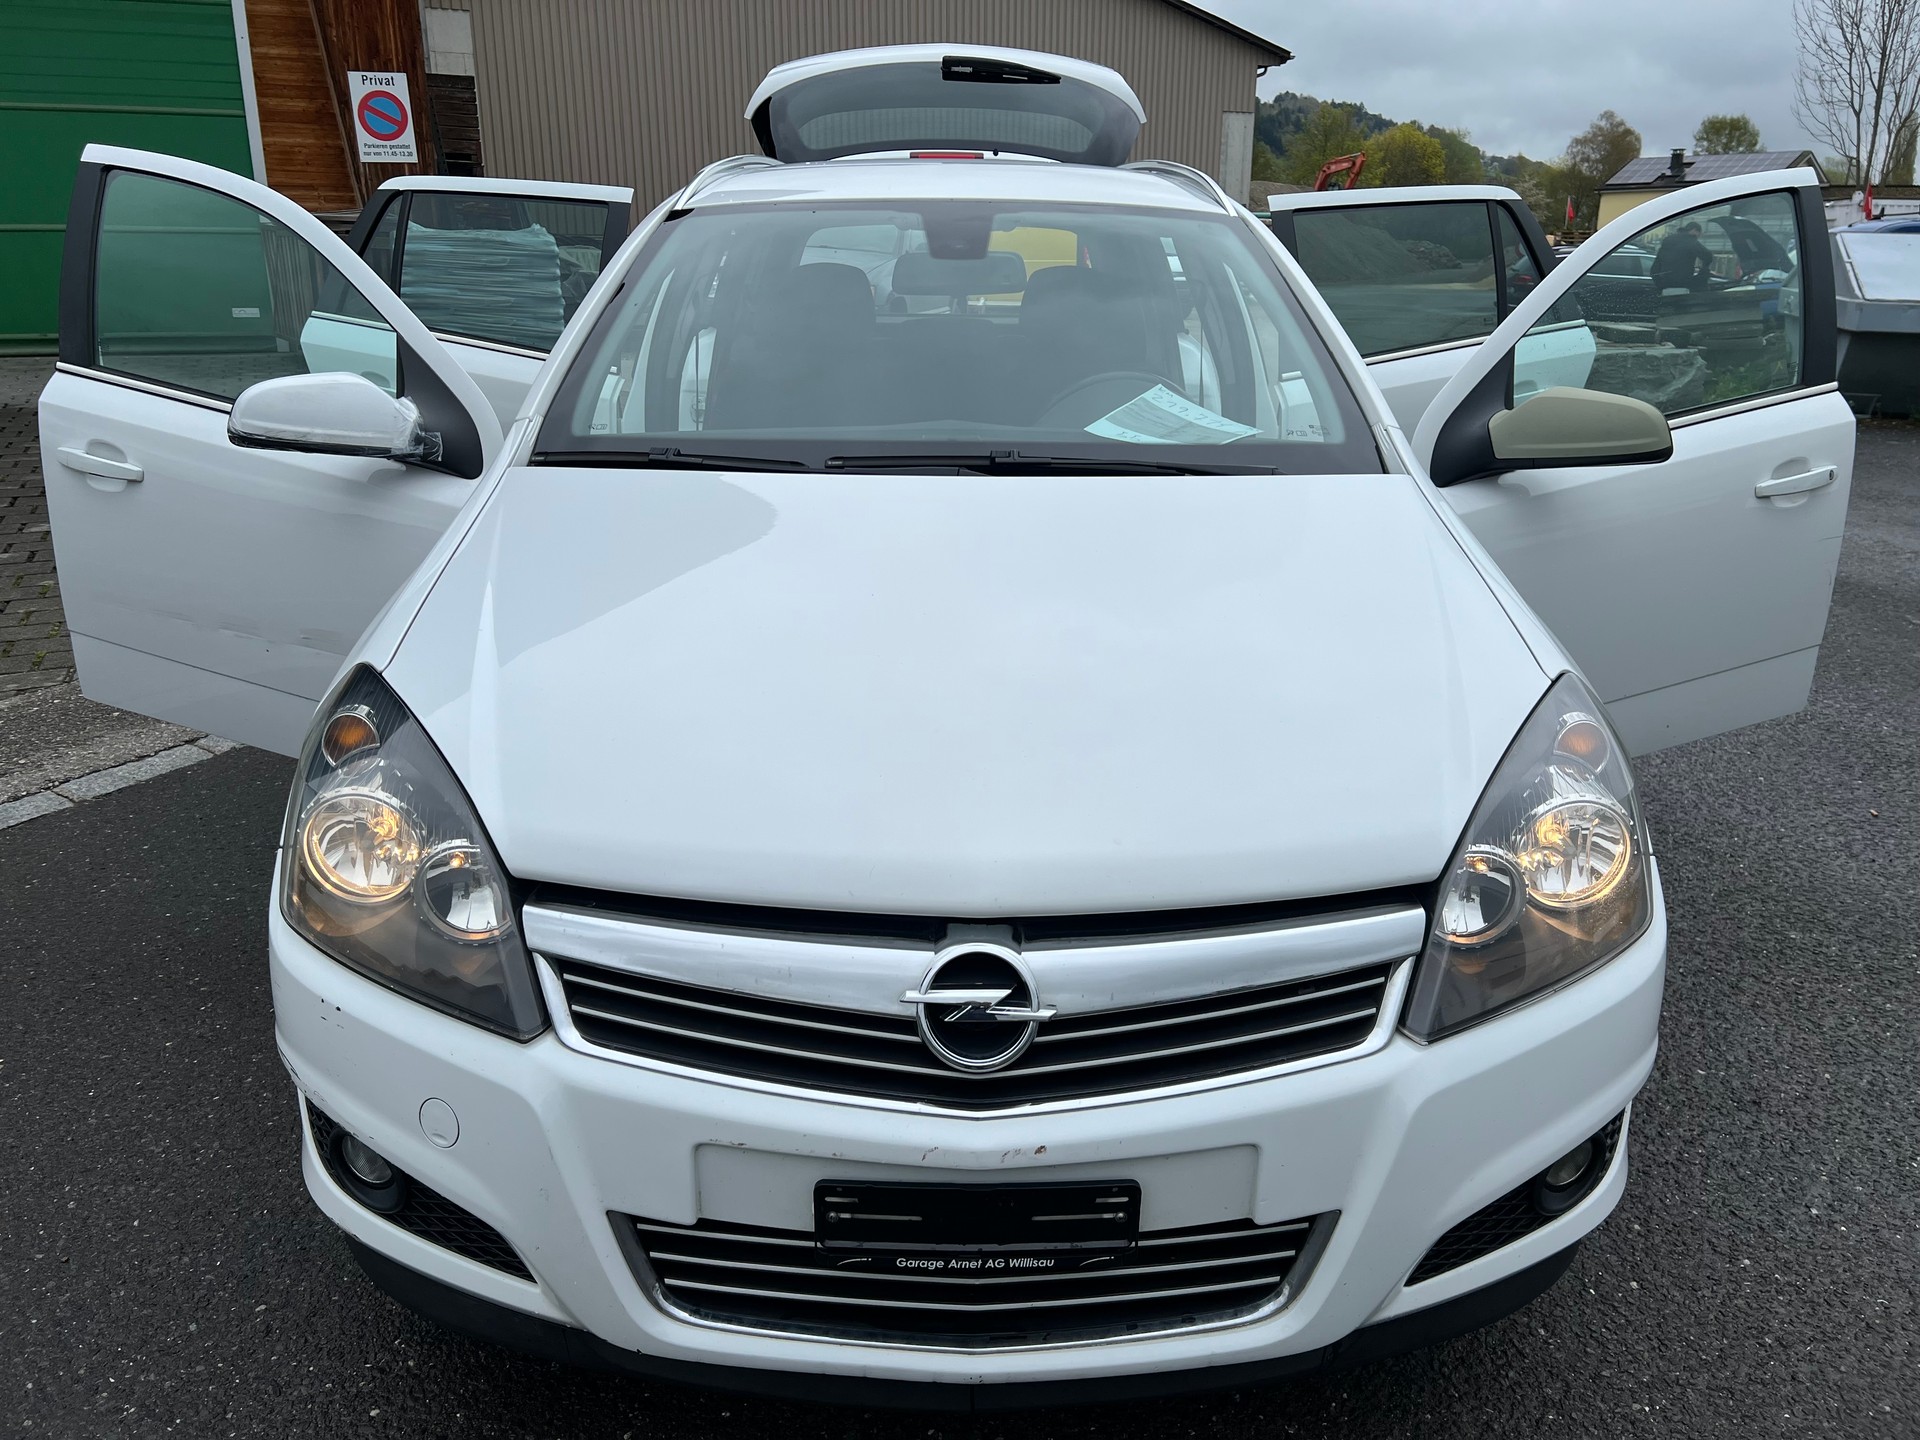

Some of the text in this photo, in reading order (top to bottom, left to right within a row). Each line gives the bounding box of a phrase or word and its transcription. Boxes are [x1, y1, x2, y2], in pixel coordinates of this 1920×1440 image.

[361, 75, 395, 86] Privat
[896, 1257, 1055, 1270] Garage Arnet AG Willisau
